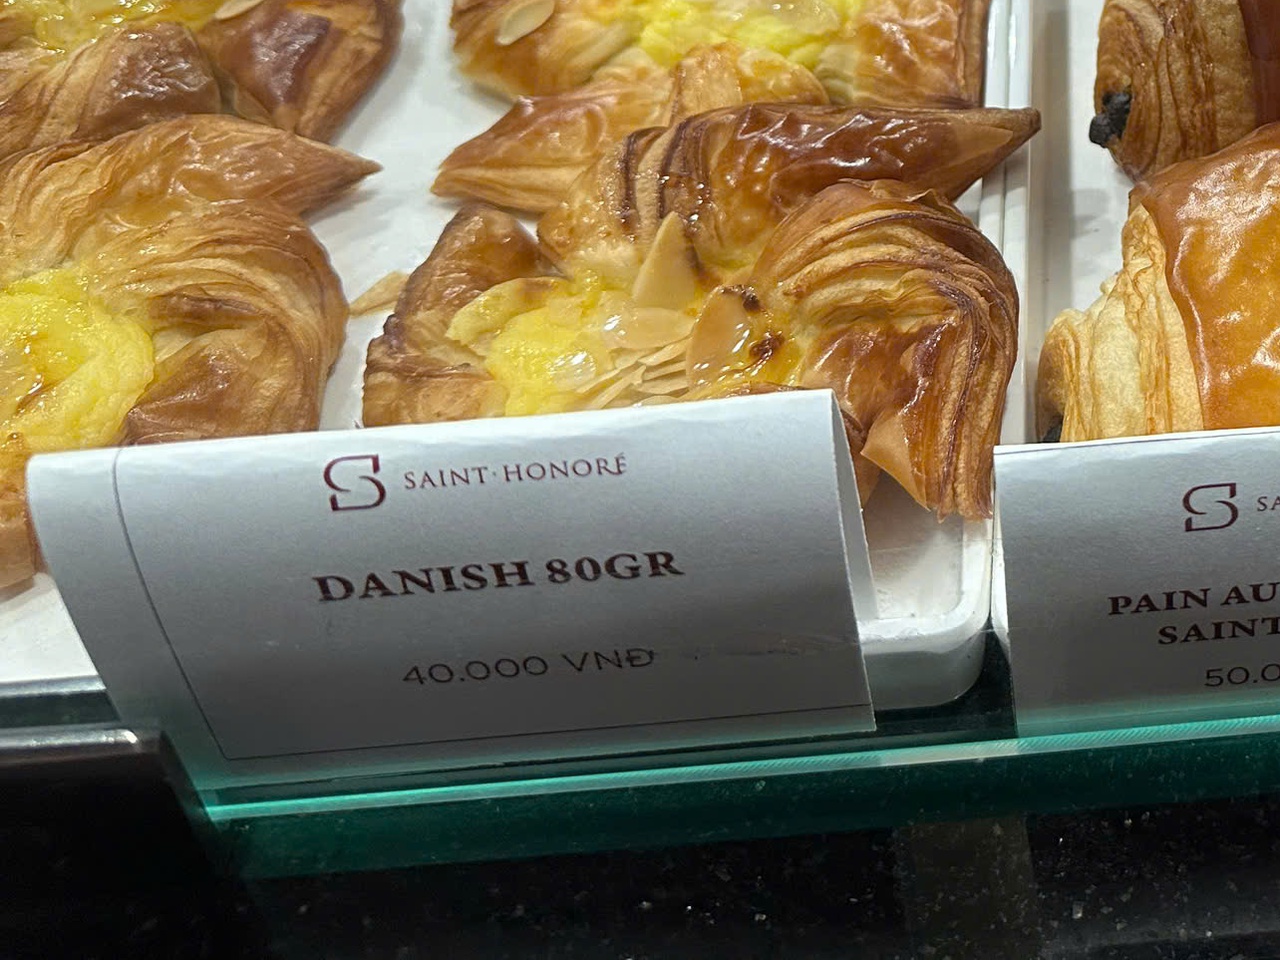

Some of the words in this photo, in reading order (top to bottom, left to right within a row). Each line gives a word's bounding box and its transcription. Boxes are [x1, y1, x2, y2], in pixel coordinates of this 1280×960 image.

[312, 559, 537, 603] DANISH
[546, 549, 686, 585] 80GR
[1107, 587, 1211, 616] PAIN
[401, 654, 550, 687] 40.000
[560, 646, 656, 674] VNĐ
